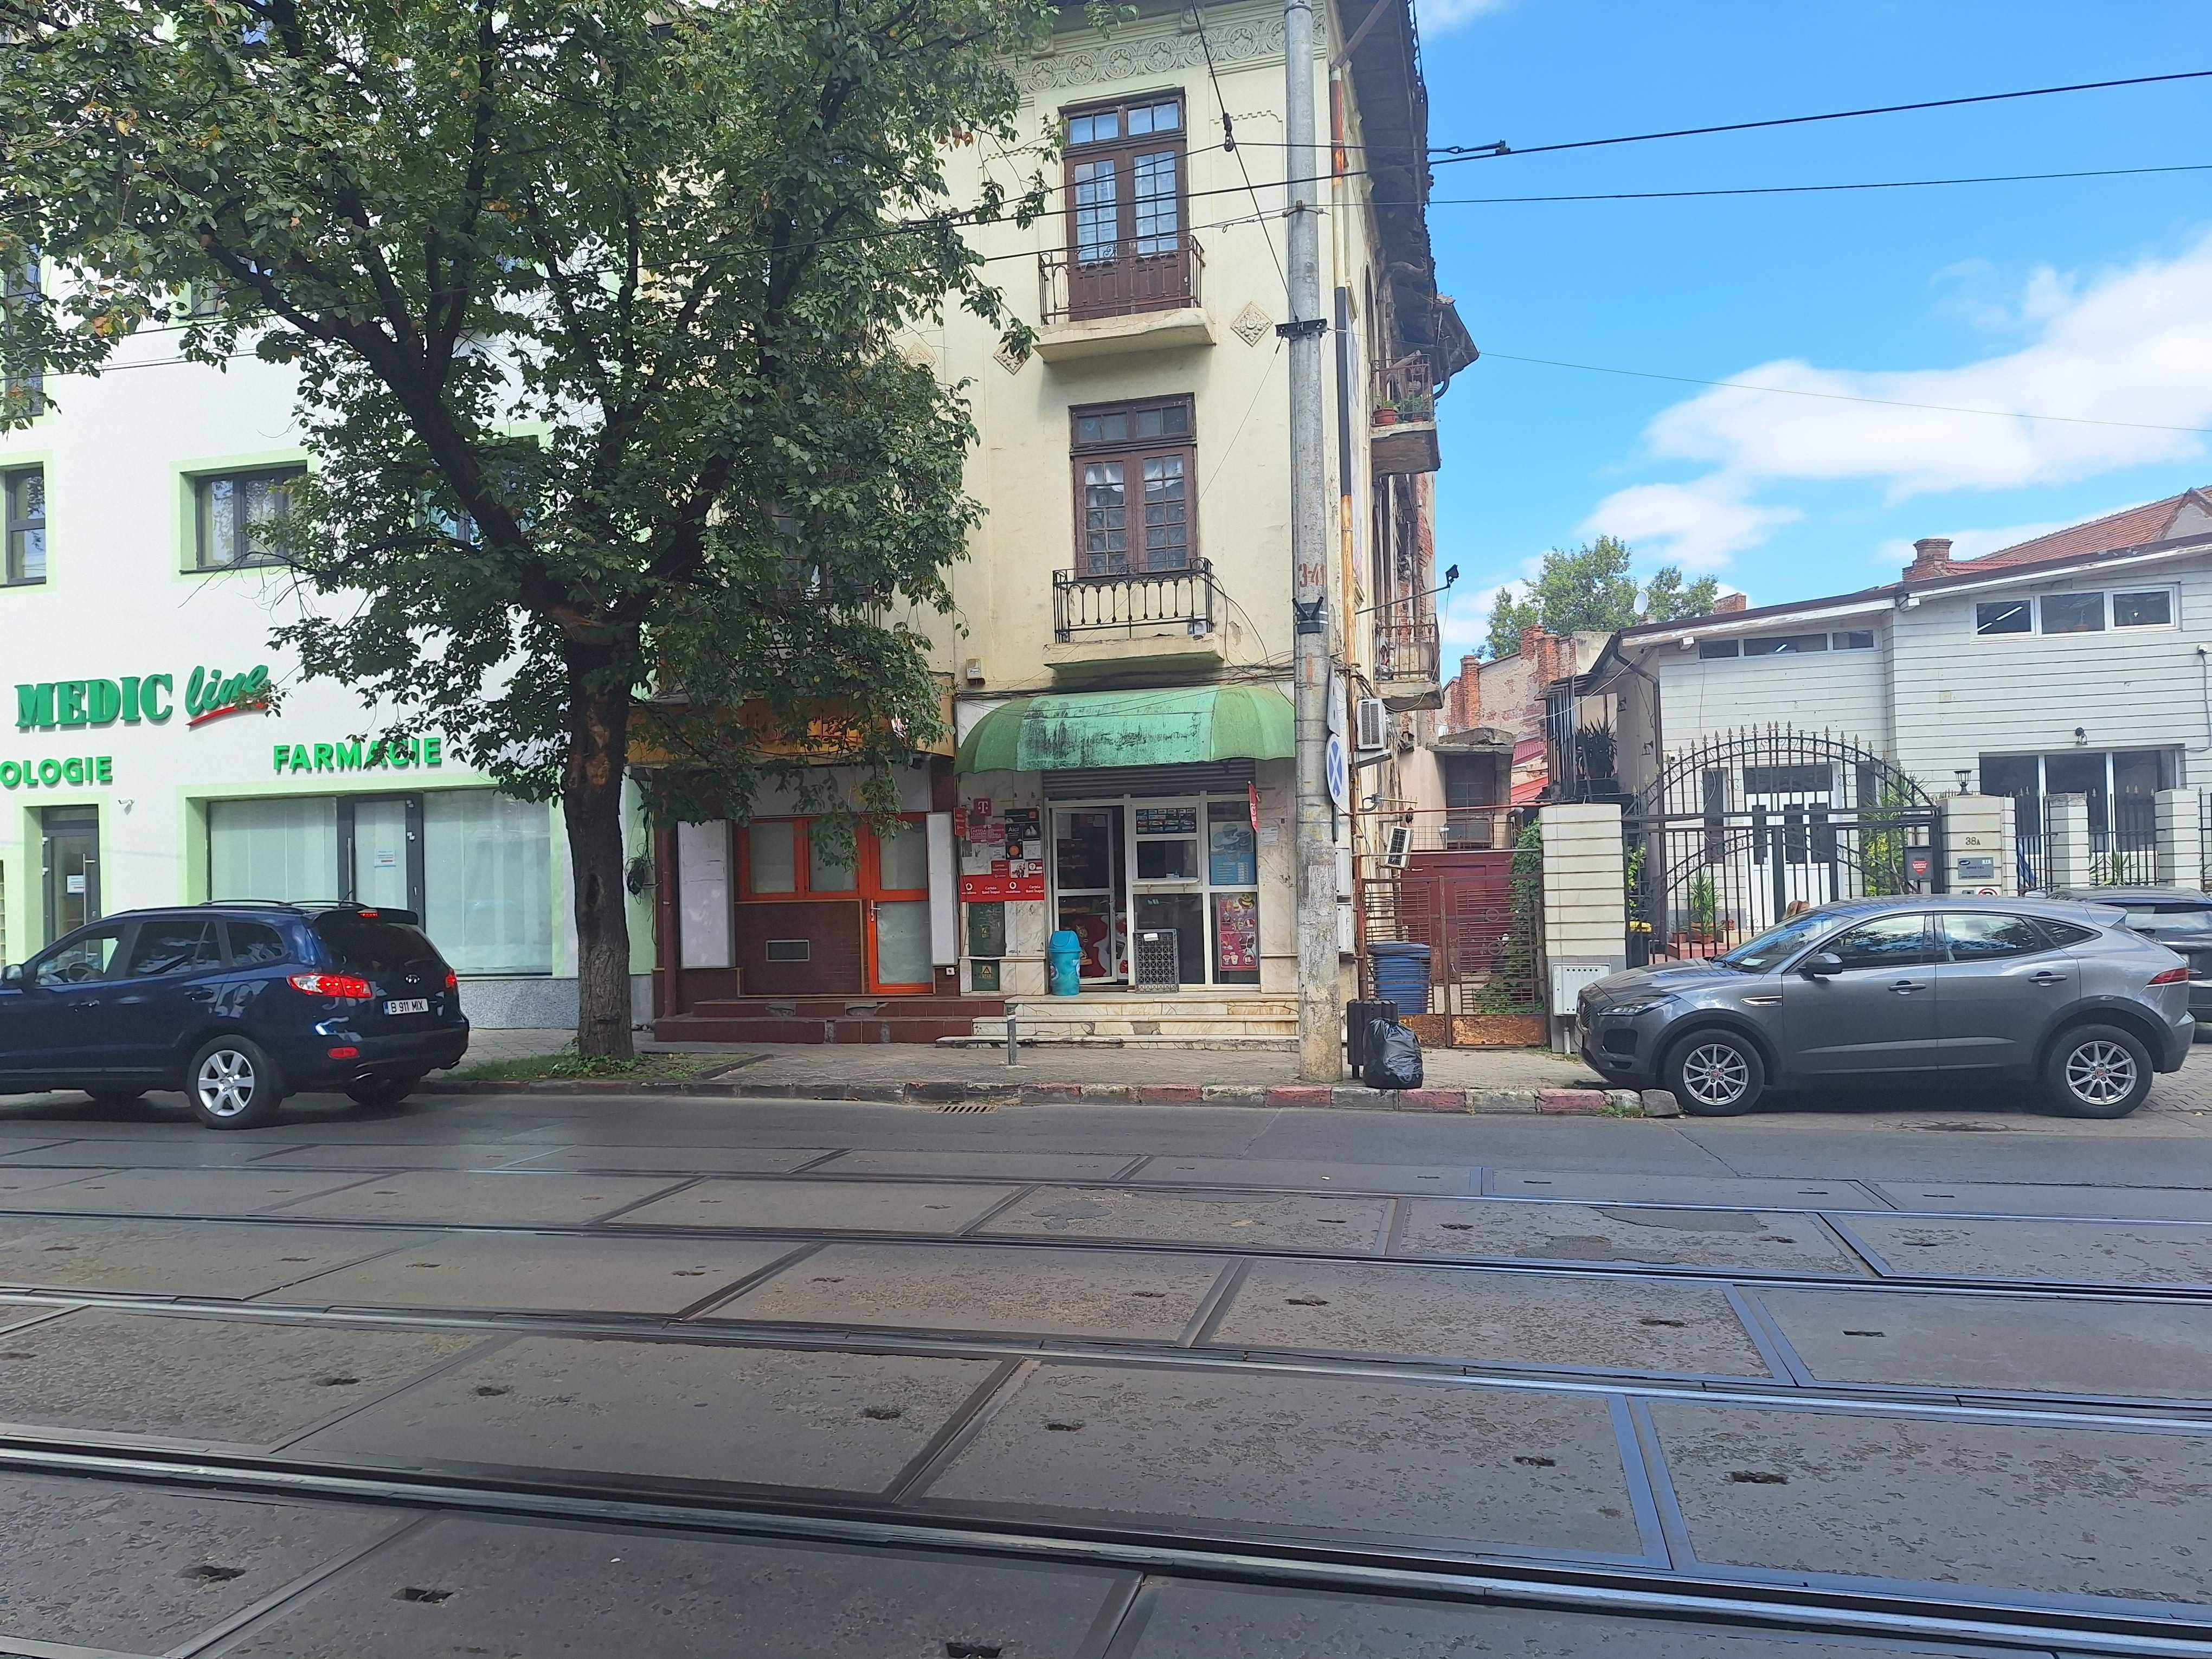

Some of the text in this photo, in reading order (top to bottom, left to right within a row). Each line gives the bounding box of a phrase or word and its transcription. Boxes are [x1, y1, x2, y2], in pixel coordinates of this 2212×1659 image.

[15, 665, 269, 728] MEDIC line
[273, 737, 442, 770] FARMACIE
[0, 756, 113, 786] OLOGIE
[1965, 837, 1980, 845] 38A
[390, 1000, 424, 1013] B 911 MIX
